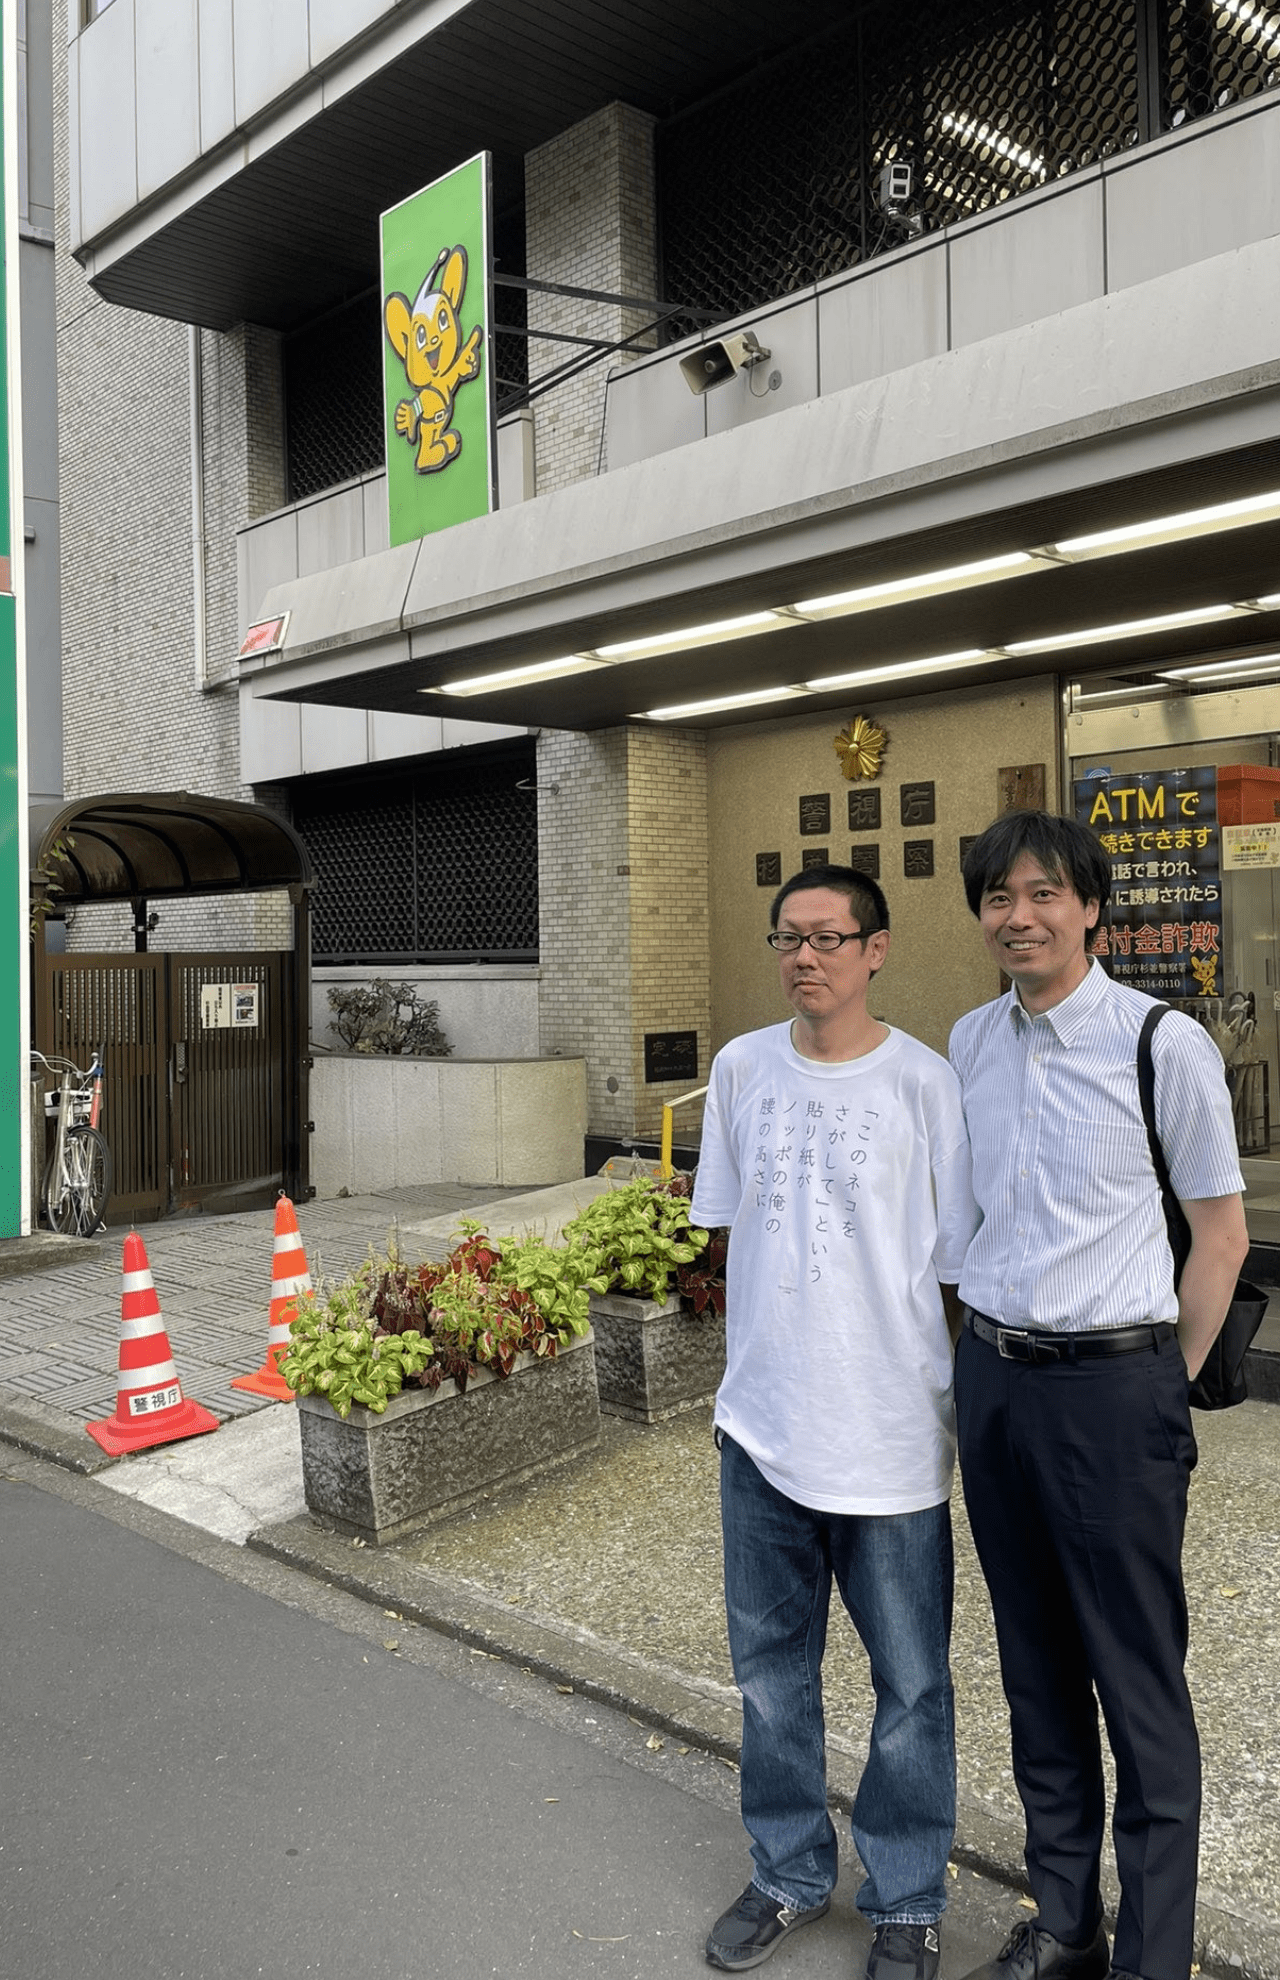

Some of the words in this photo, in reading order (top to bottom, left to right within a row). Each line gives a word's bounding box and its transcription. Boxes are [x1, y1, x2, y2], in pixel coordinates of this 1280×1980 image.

[802, 789, 930, 830] 警視庁
[1090, 785, 1199, 824] ATMで
[1106, 885, 1219, 906] に誘導されたら
[754, 1097, 776, 1208] 腰の高さに
[765, 1100, 797, 1234] ノッポの俺の
[797, 1100, 824, 1189] 貼り紙が
[842, 1109, 879, 1238] 「このネコを
[811, 1105, 849, 1283] さがして」という
[134, 1388, 178, 1413] 警視庁
